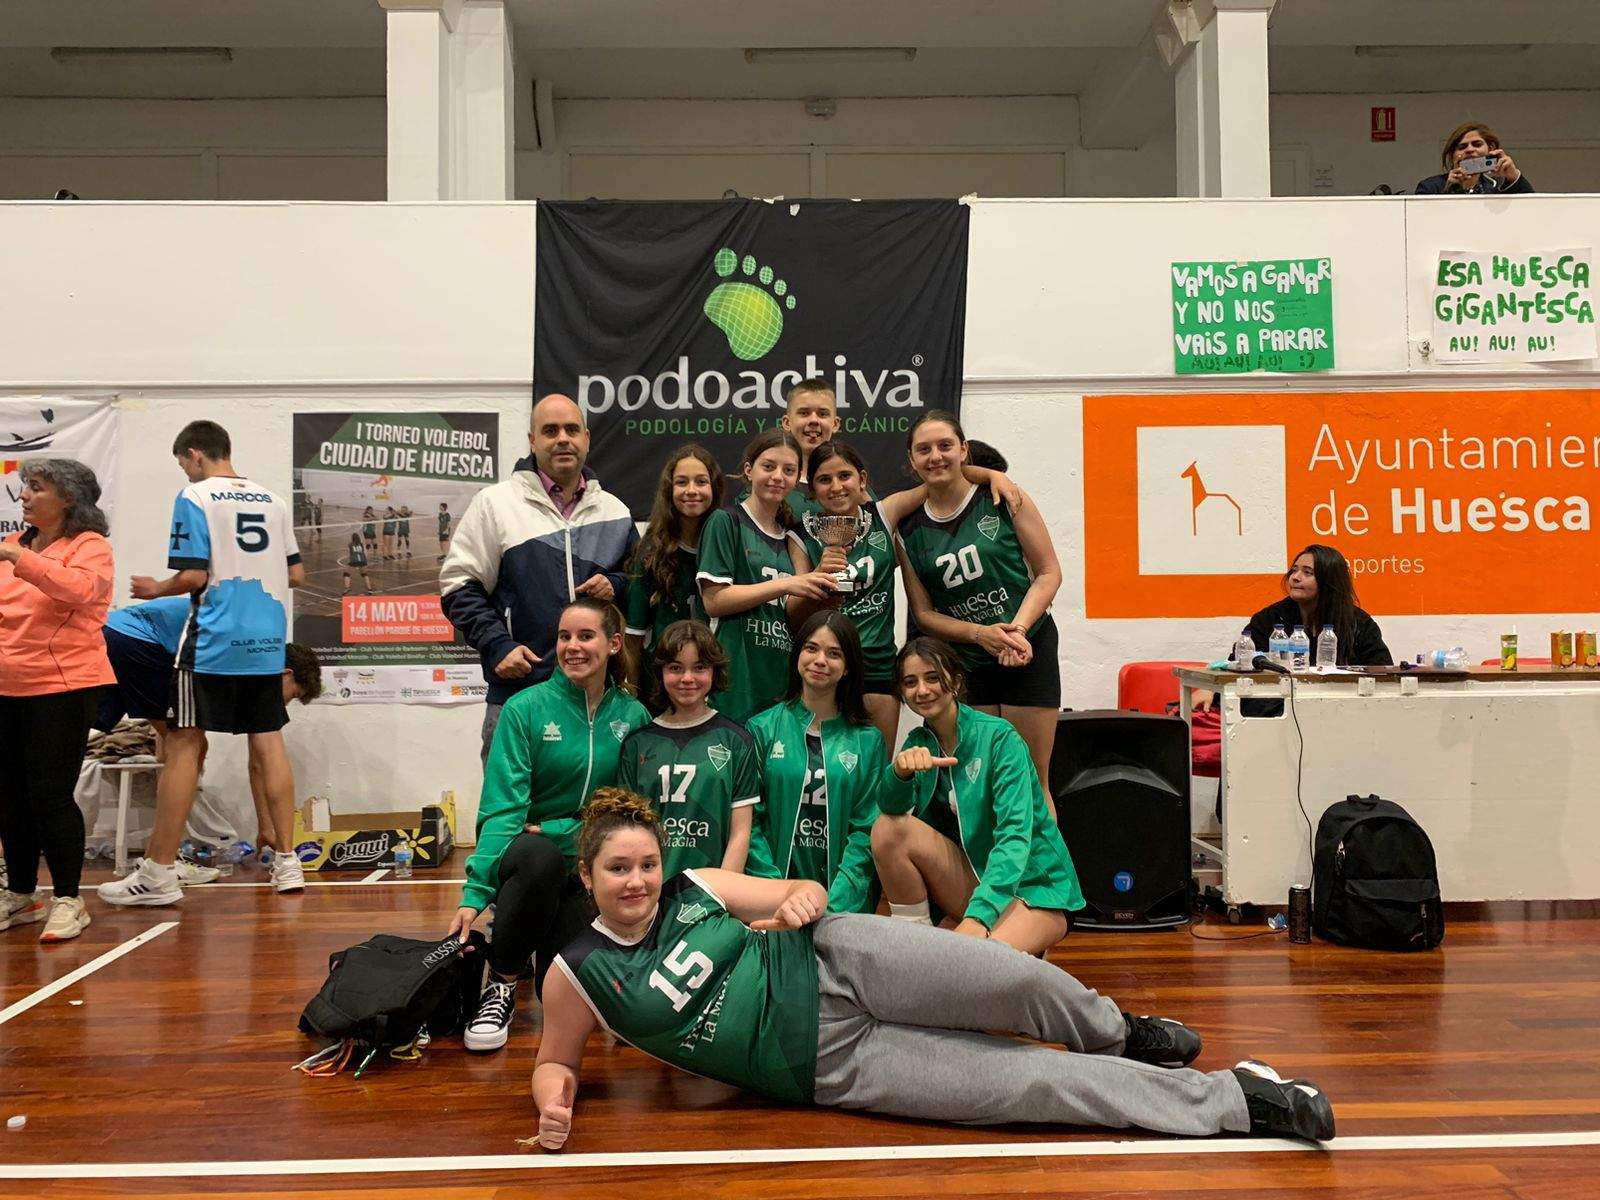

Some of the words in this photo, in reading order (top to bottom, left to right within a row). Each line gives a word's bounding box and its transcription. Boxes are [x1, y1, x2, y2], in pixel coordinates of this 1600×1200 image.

[1172, 264, 1238, 297] VAMOS
[1242, 271, 1257, 293] A
[1261, 259, 1332, 294] GANAR
[1437, 259, 1483, 288] ESA
[1492, 255, 1590, 289] HUESCA
[1174, 301, 1188, 325] Y
[1197, 300, 1225, 323] NO
[1234, 299, 1276, 324] NOS
[1236, 333, 1250, 355] A
[1258, 327, 1329, 352] PARAR
[1449, 335, 1479, 352] AU!
[1488, 334, 1516, 352] AU!
[1527, 335, 1556, 353] AU!
[356, 422, 362, 439] I
[365, 422, 421, 445] TORNEO
[424, 428, 491, 451] VOLEIBOL
[625, 414, 748, 436] PODOLOGÍA
[756, 417, 767, 434] Y
[320, 441, 389, 469] CIUDAD
[392, 448, 417, 473] DE
[421, 450, 495, 479] HUESCA
[210, 492, 273, 503] MARCOS
[1311, 489, 1370, 536] de
[1391, 487, 1591, 534] Huesca
[236, 511, 270, 553] 5
[935, 543, 984, 590] 20
[348, 601, 368, 622] 14
[371, 601, 418, 622] MAYO
[657, 763, 697, 804] 17
[663, 817, 709, 837] esca
[329, 833, 390, 867] Cuqui
[649, 940, 714, 1014] 15
